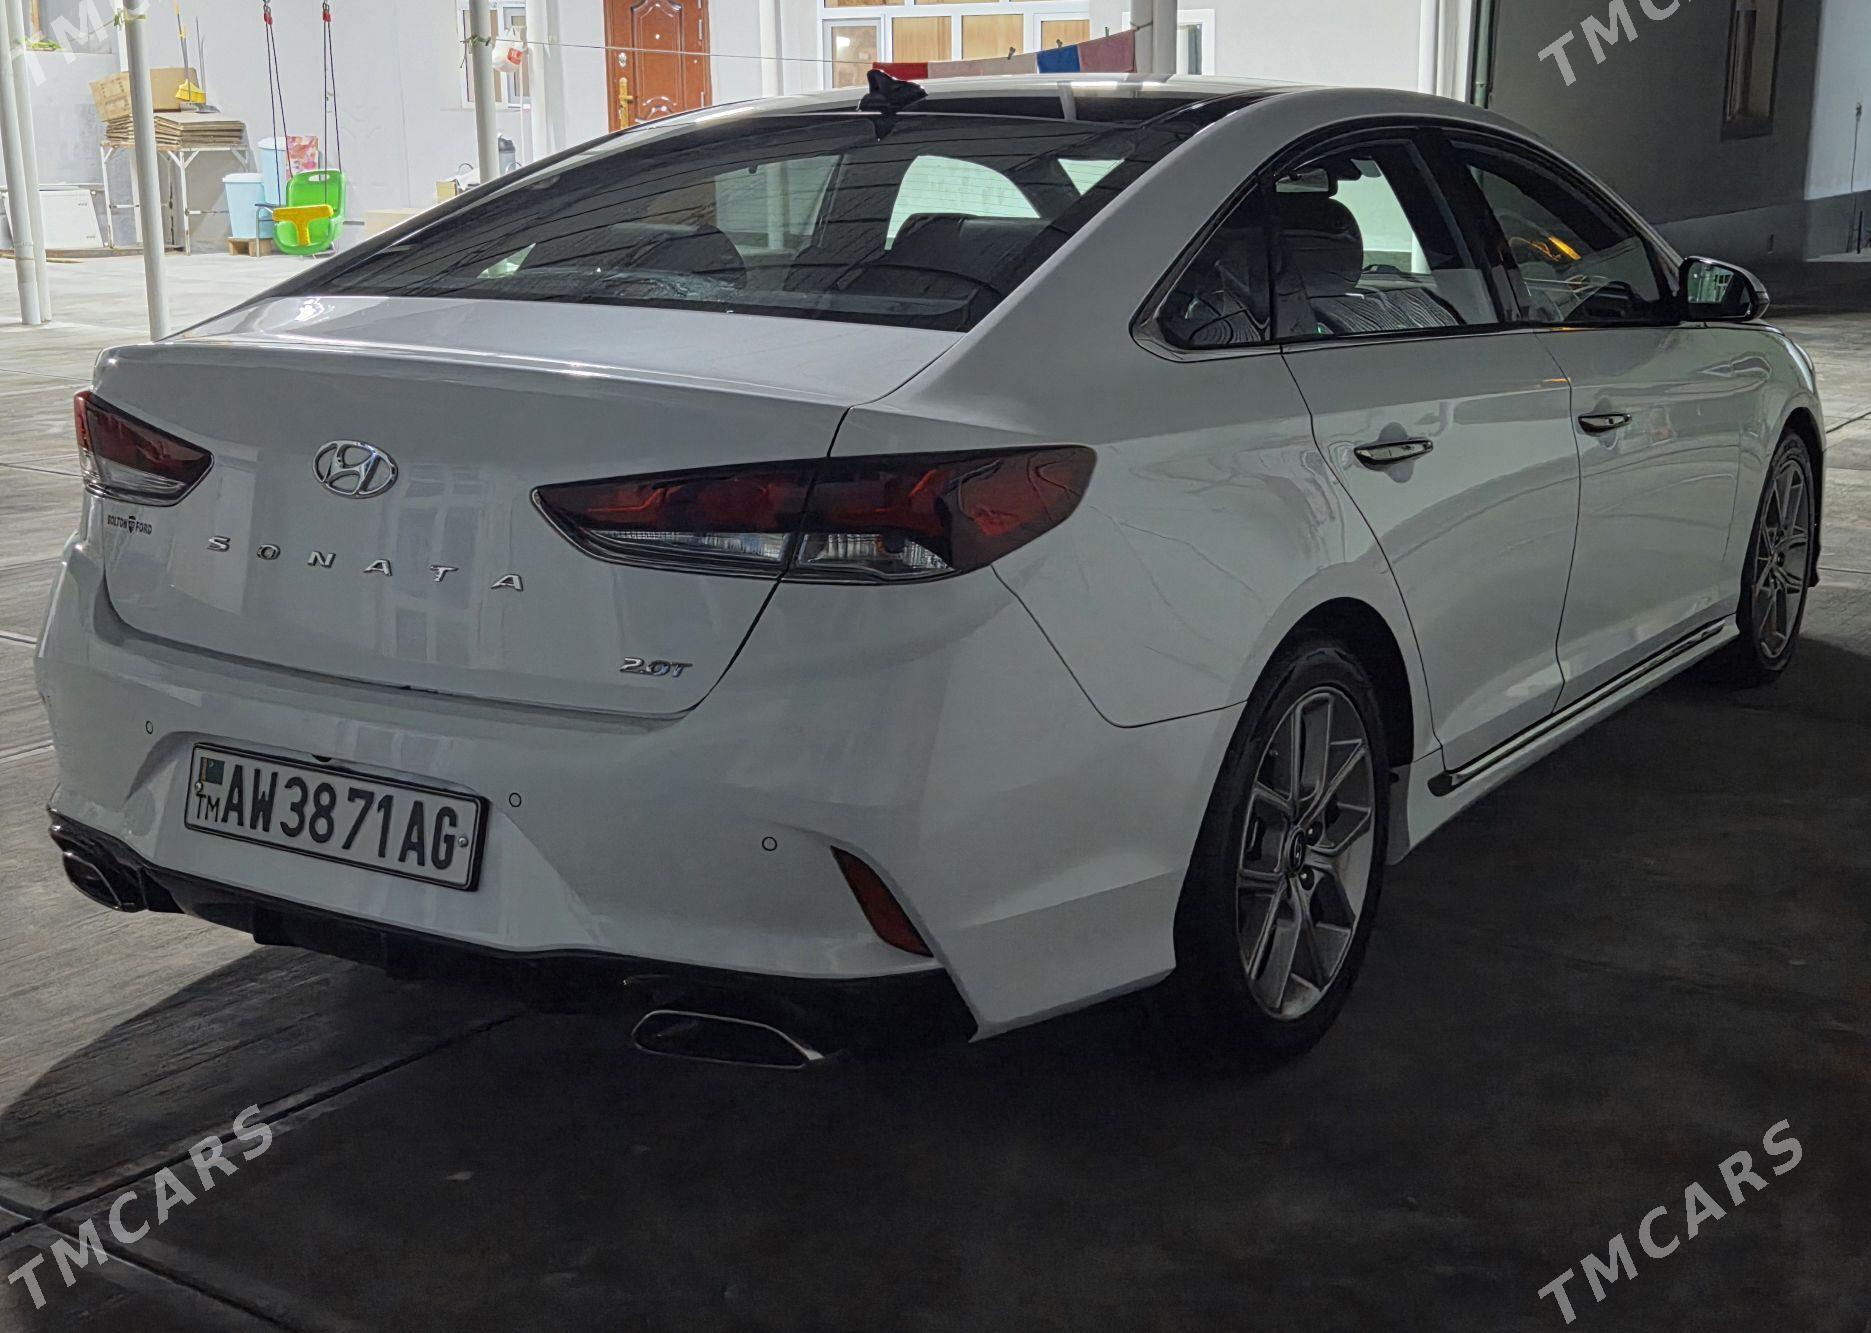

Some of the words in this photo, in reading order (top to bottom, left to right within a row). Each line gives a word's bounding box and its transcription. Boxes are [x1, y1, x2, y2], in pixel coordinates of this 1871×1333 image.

[136, 521, 153, 535] FORD
[206, 535, 524, 592] SONATA
[620, 656, 693, 678] 2.0T
[195, 791, 220, 823] TM
[221, 764, 458, 870] AW3871AG
